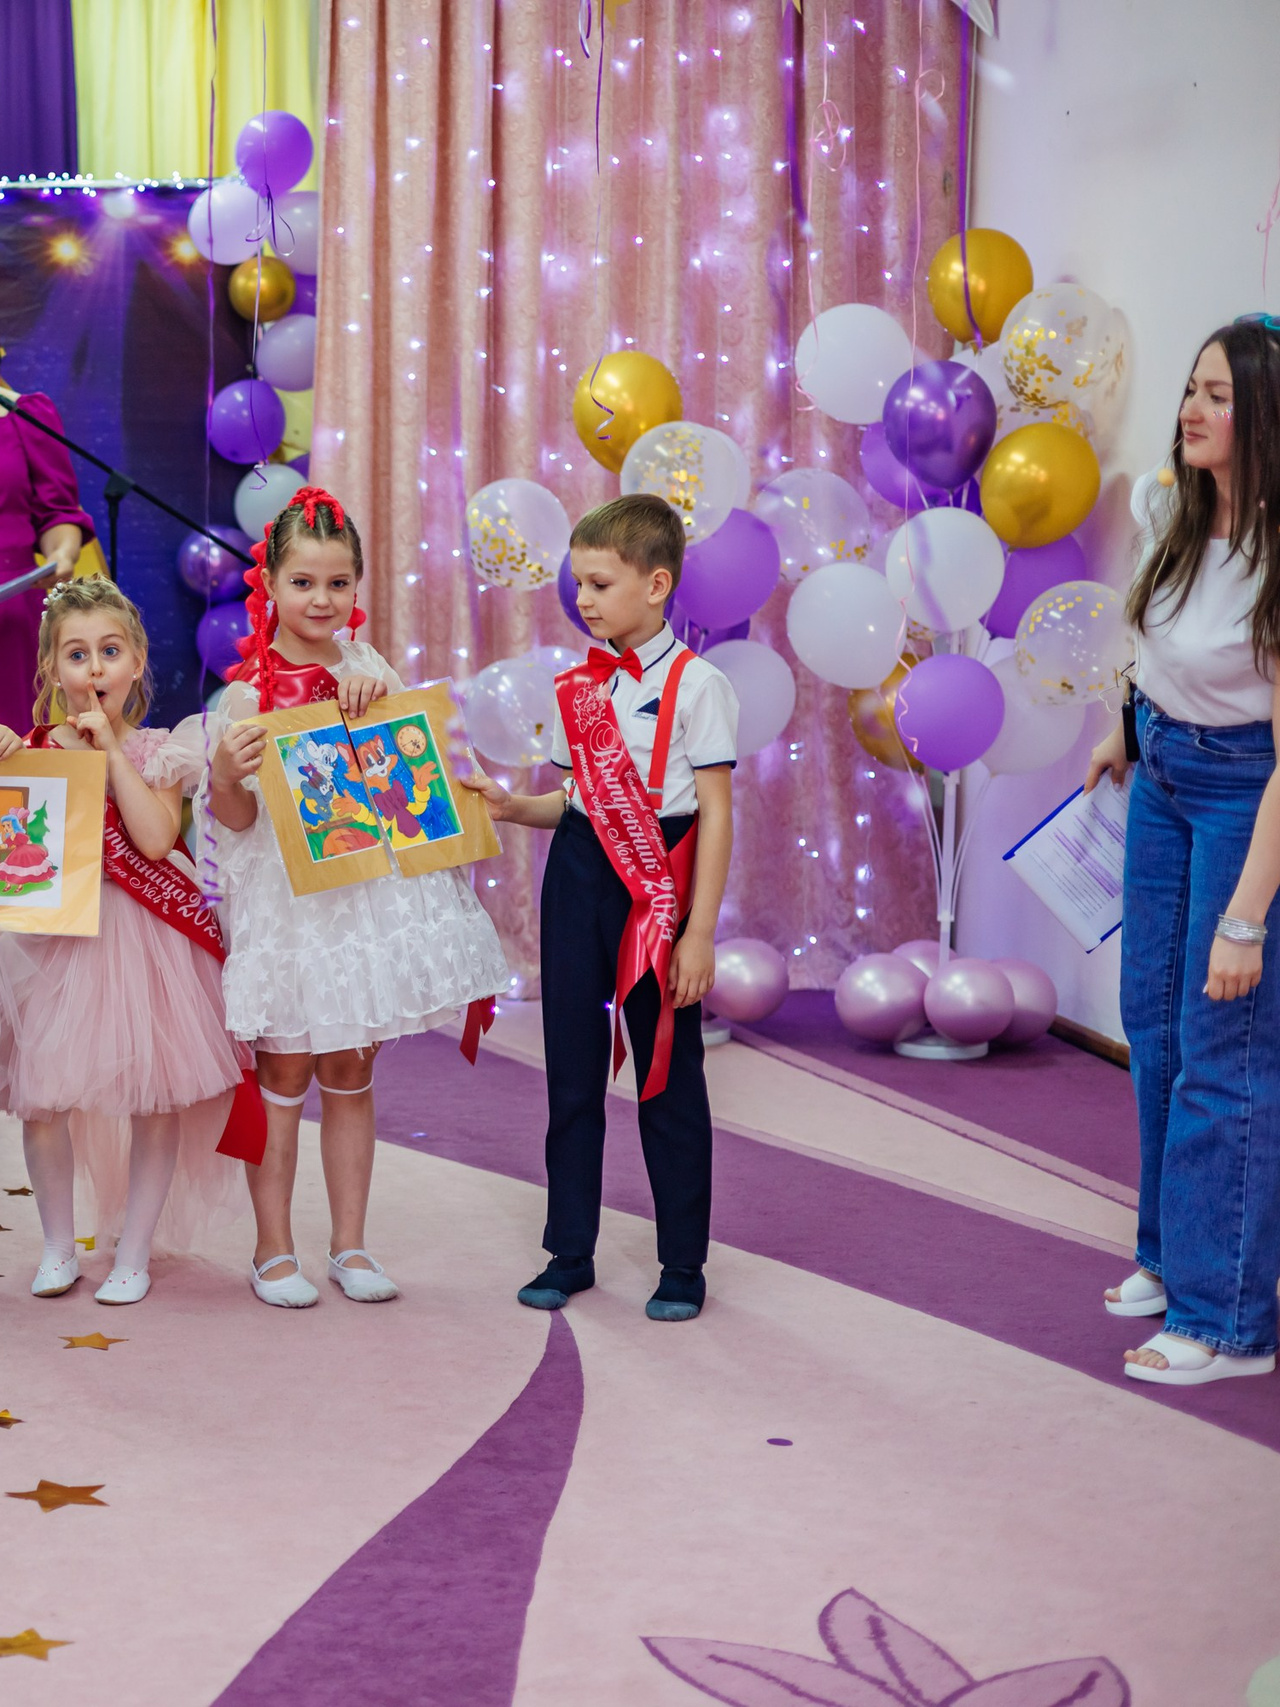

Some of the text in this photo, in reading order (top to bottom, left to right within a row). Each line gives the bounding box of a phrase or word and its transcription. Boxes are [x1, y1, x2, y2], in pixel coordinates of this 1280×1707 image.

[571, 743, 633, 864] детского сада №4
[590, 720, 661, 873] Выпускник
[640, 876, 677, 943] 2024
[105, 823, 187, 903] пускница
[129, 876, 161, 904] №4
